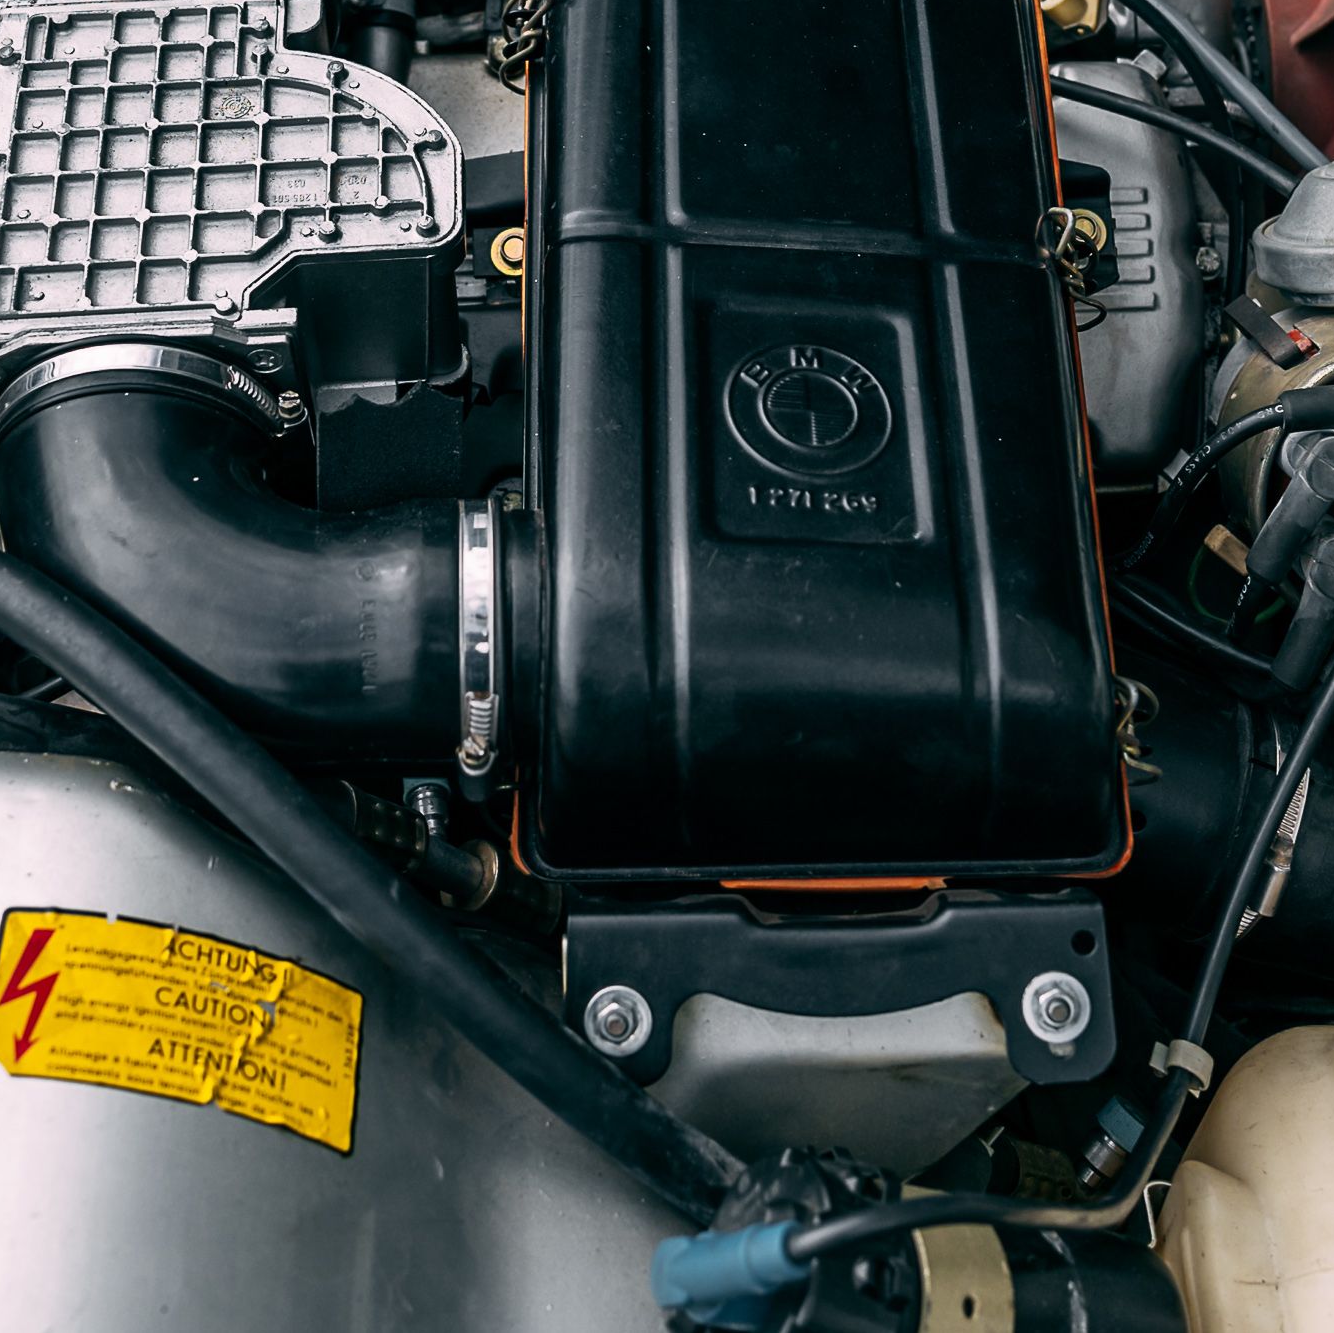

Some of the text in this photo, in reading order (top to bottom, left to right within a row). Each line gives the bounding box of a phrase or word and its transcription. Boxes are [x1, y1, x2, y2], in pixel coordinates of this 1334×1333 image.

[740, 346, 878, 396] BMW
[1184, 444, 1212, 475] CLASS
[155, 985, 267, 1030] CAUTION
[148, 1037, 286, 1093] ATTENTION!
